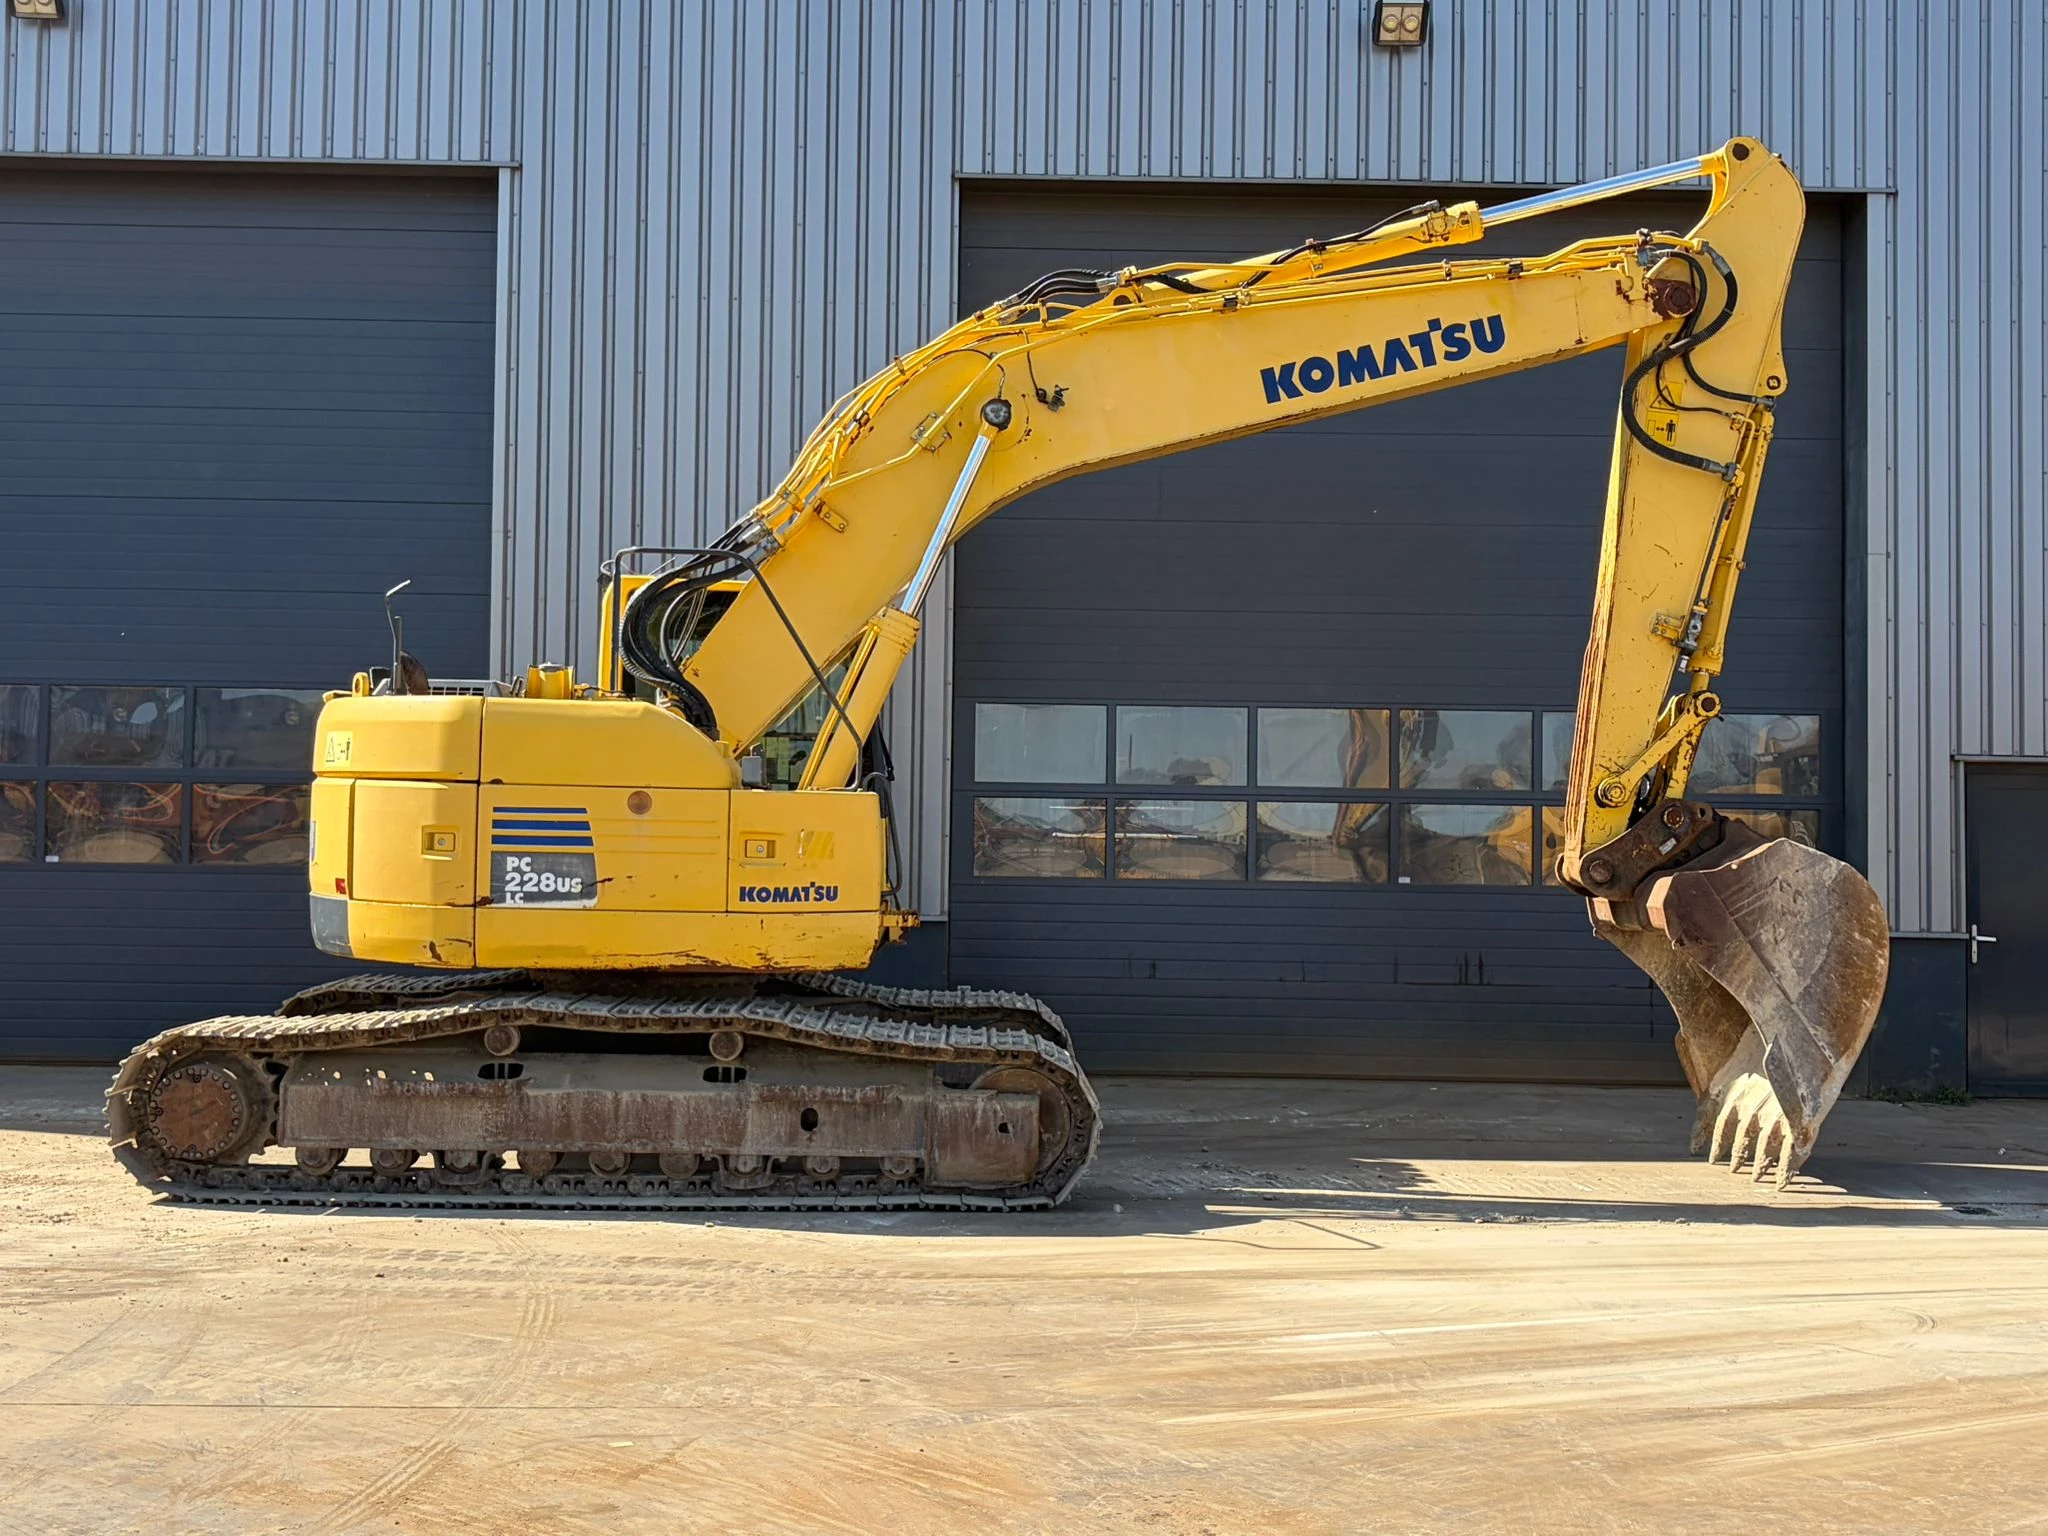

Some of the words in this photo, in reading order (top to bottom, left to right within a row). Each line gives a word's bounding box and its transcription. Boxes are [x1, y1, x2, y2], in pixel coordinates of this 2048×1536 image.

[1260, 314, 1506, 404] KOMATSU
[506, 856, 532, 872] PC
[505, 892, 525, 904] LC
[739, 881, 839, 903] KOMATSU
